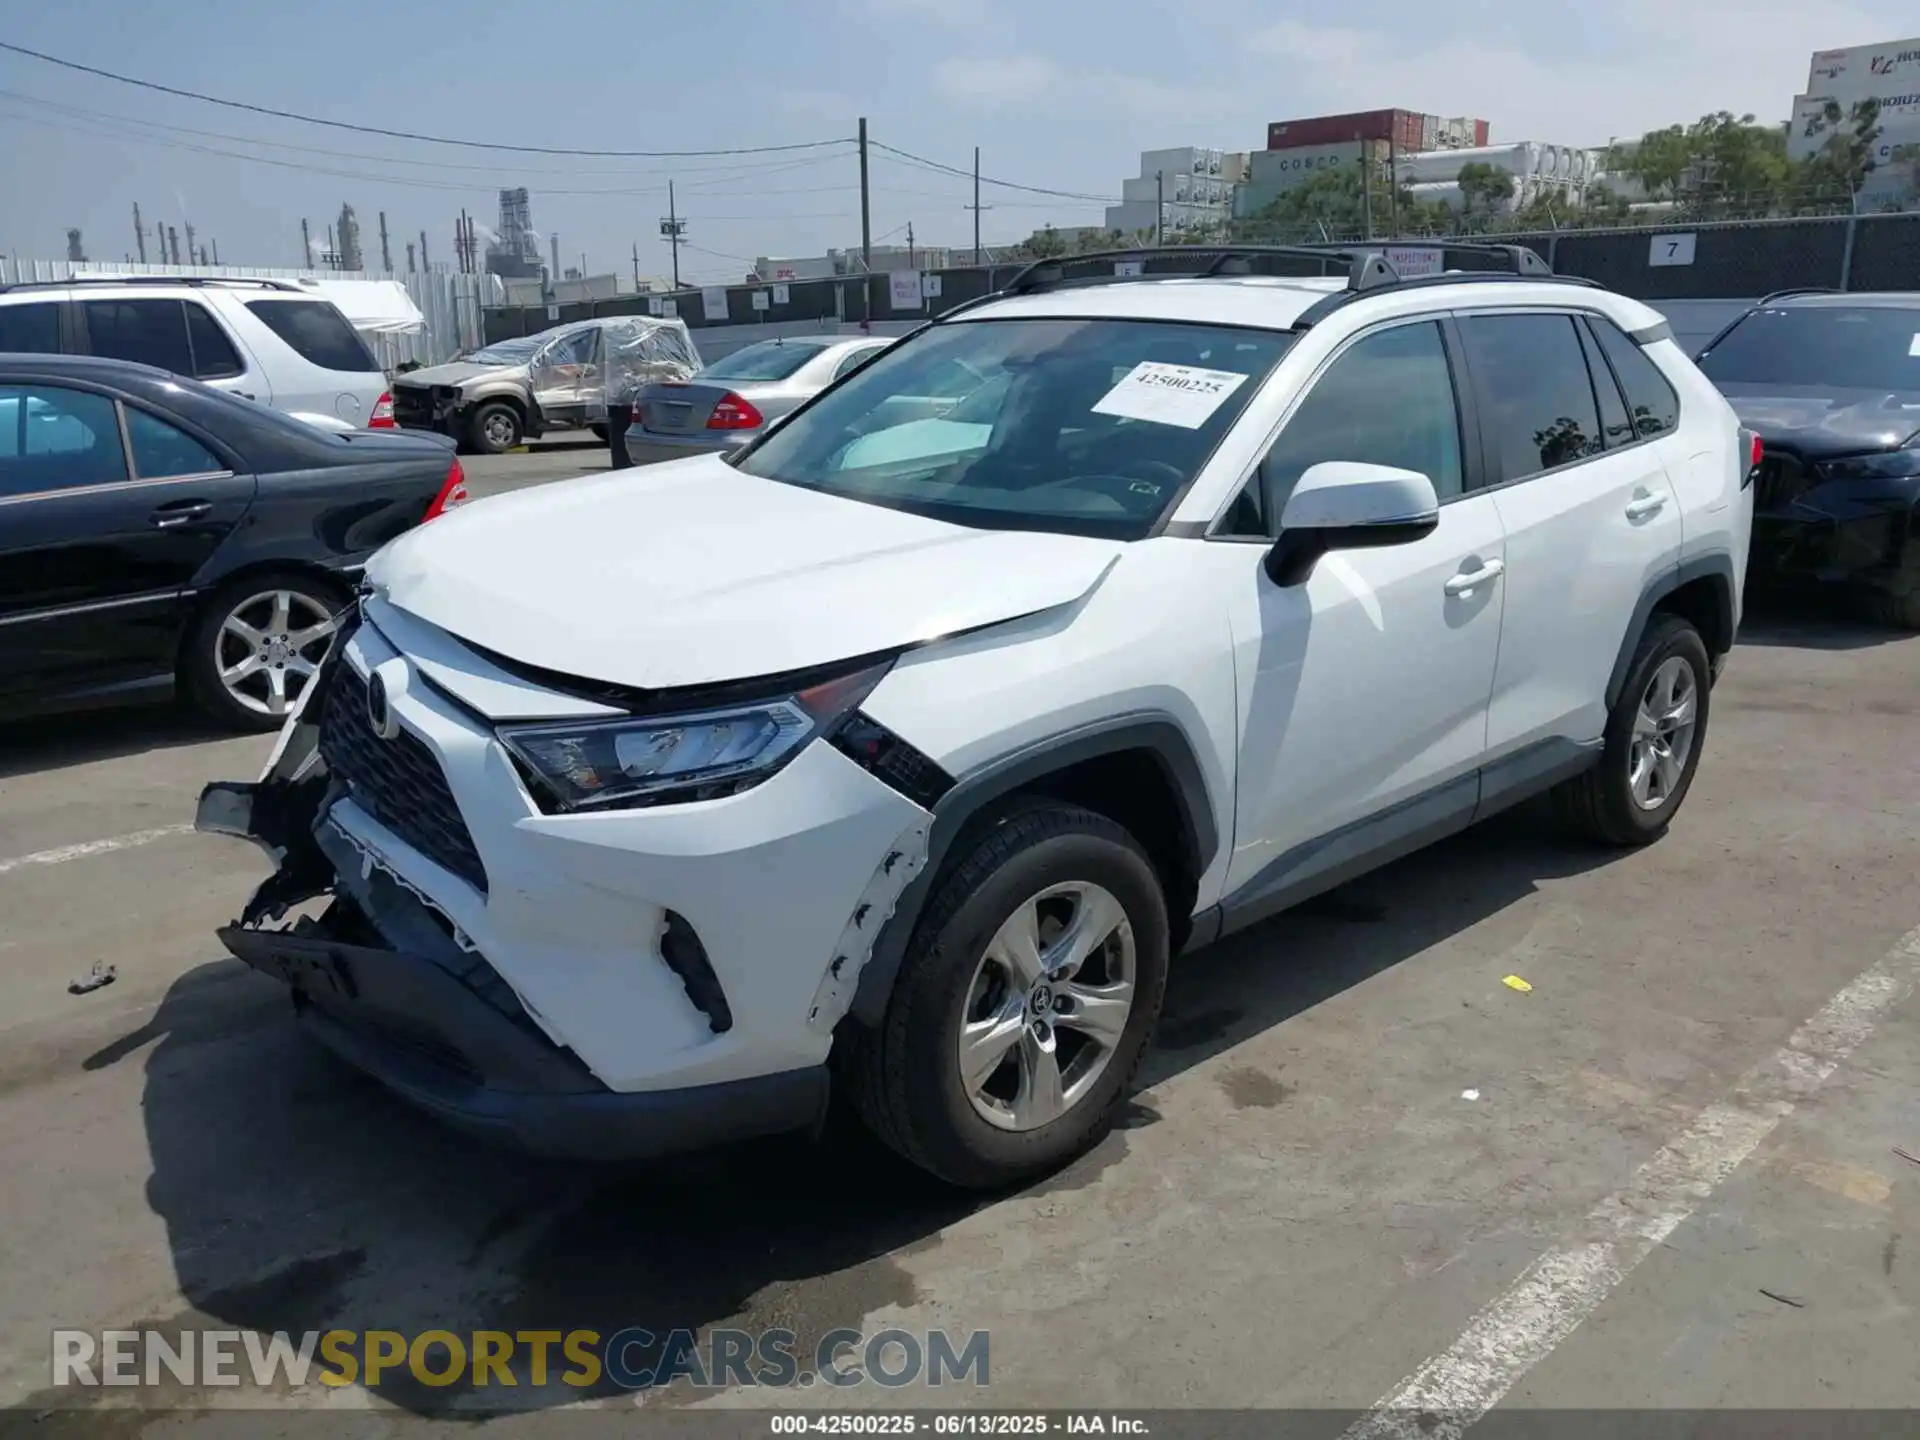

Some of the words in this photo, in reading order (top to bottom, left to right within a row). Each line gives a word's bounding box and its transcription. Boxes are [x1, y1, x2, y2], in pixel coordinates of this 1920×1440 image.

[1280, 154, 1340, 171] COSCO
[1667, 242, 1678, 257] 7
[1136, 372, 1225, 393] 42500225
